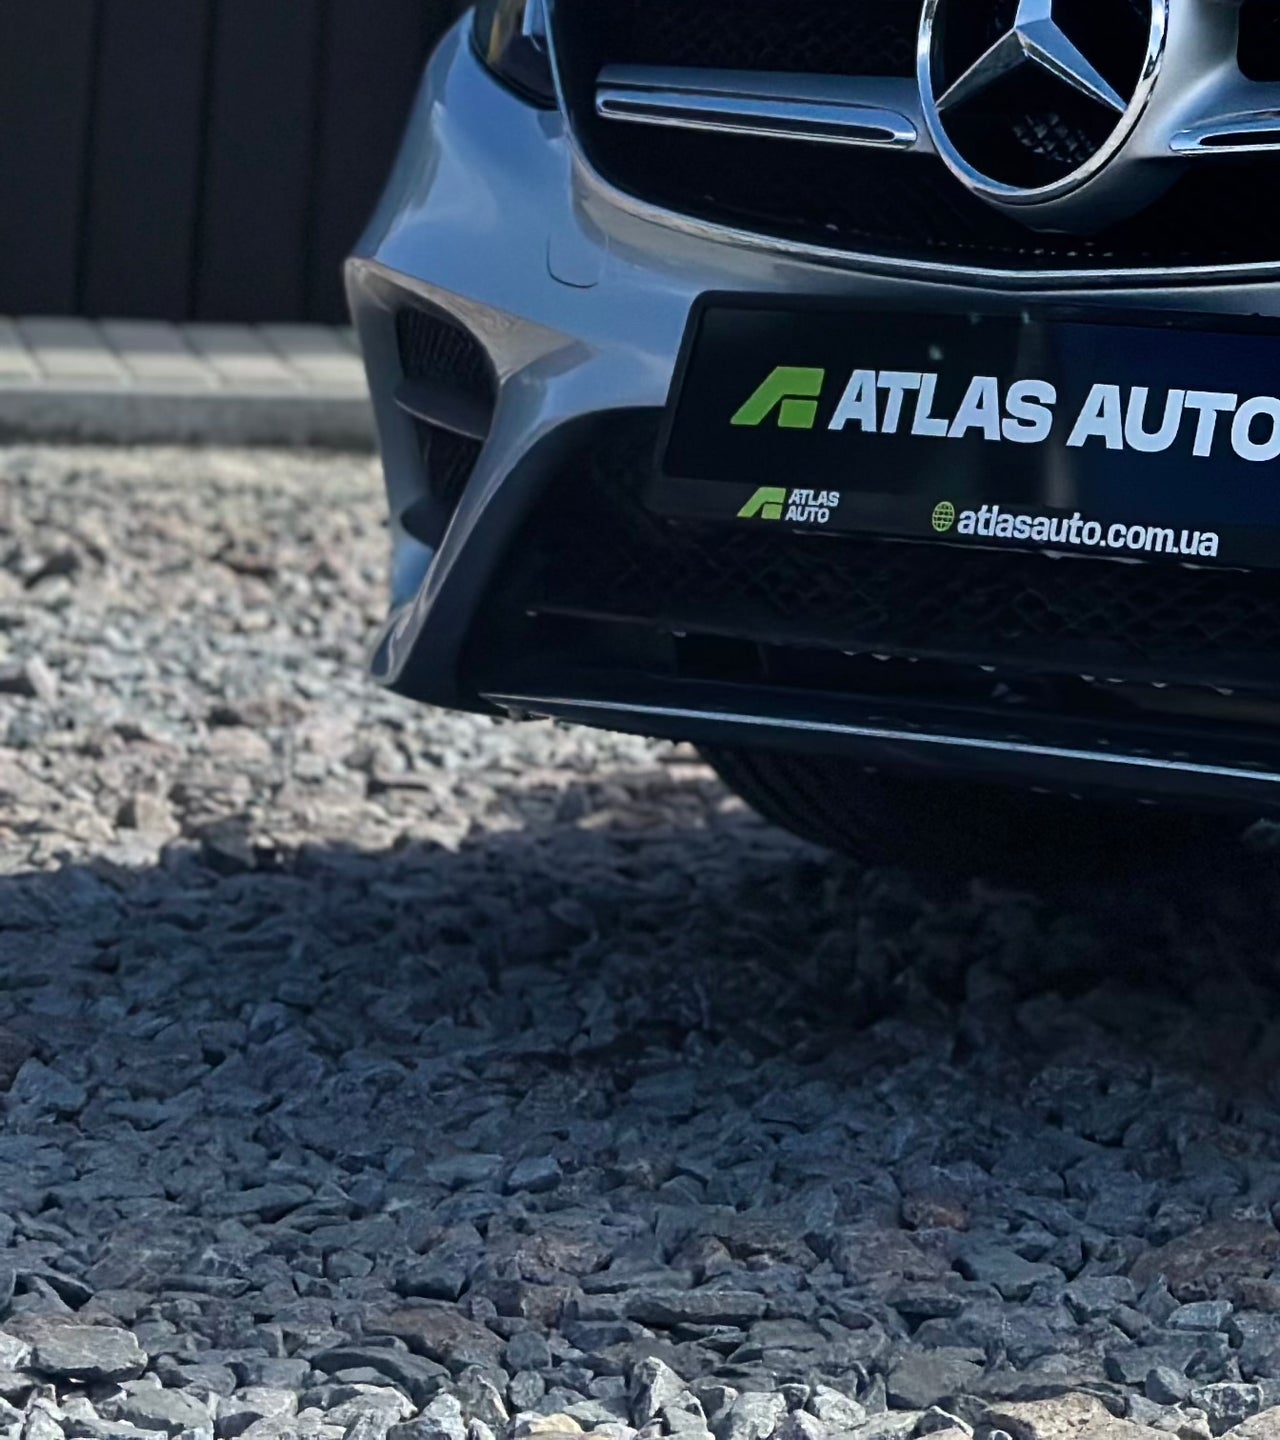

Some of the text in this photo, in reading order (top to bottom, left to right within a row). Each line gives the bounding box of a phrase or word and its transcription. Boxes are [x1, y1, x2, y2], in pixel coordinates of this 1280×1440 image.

[827, 369, 1057, 444] ATLAS
[784, 505, 830, 524] AUTO
[788, 488, 840, 507] ATLAS
[956, 504, 1219, 557] atlasauto.com.ua
